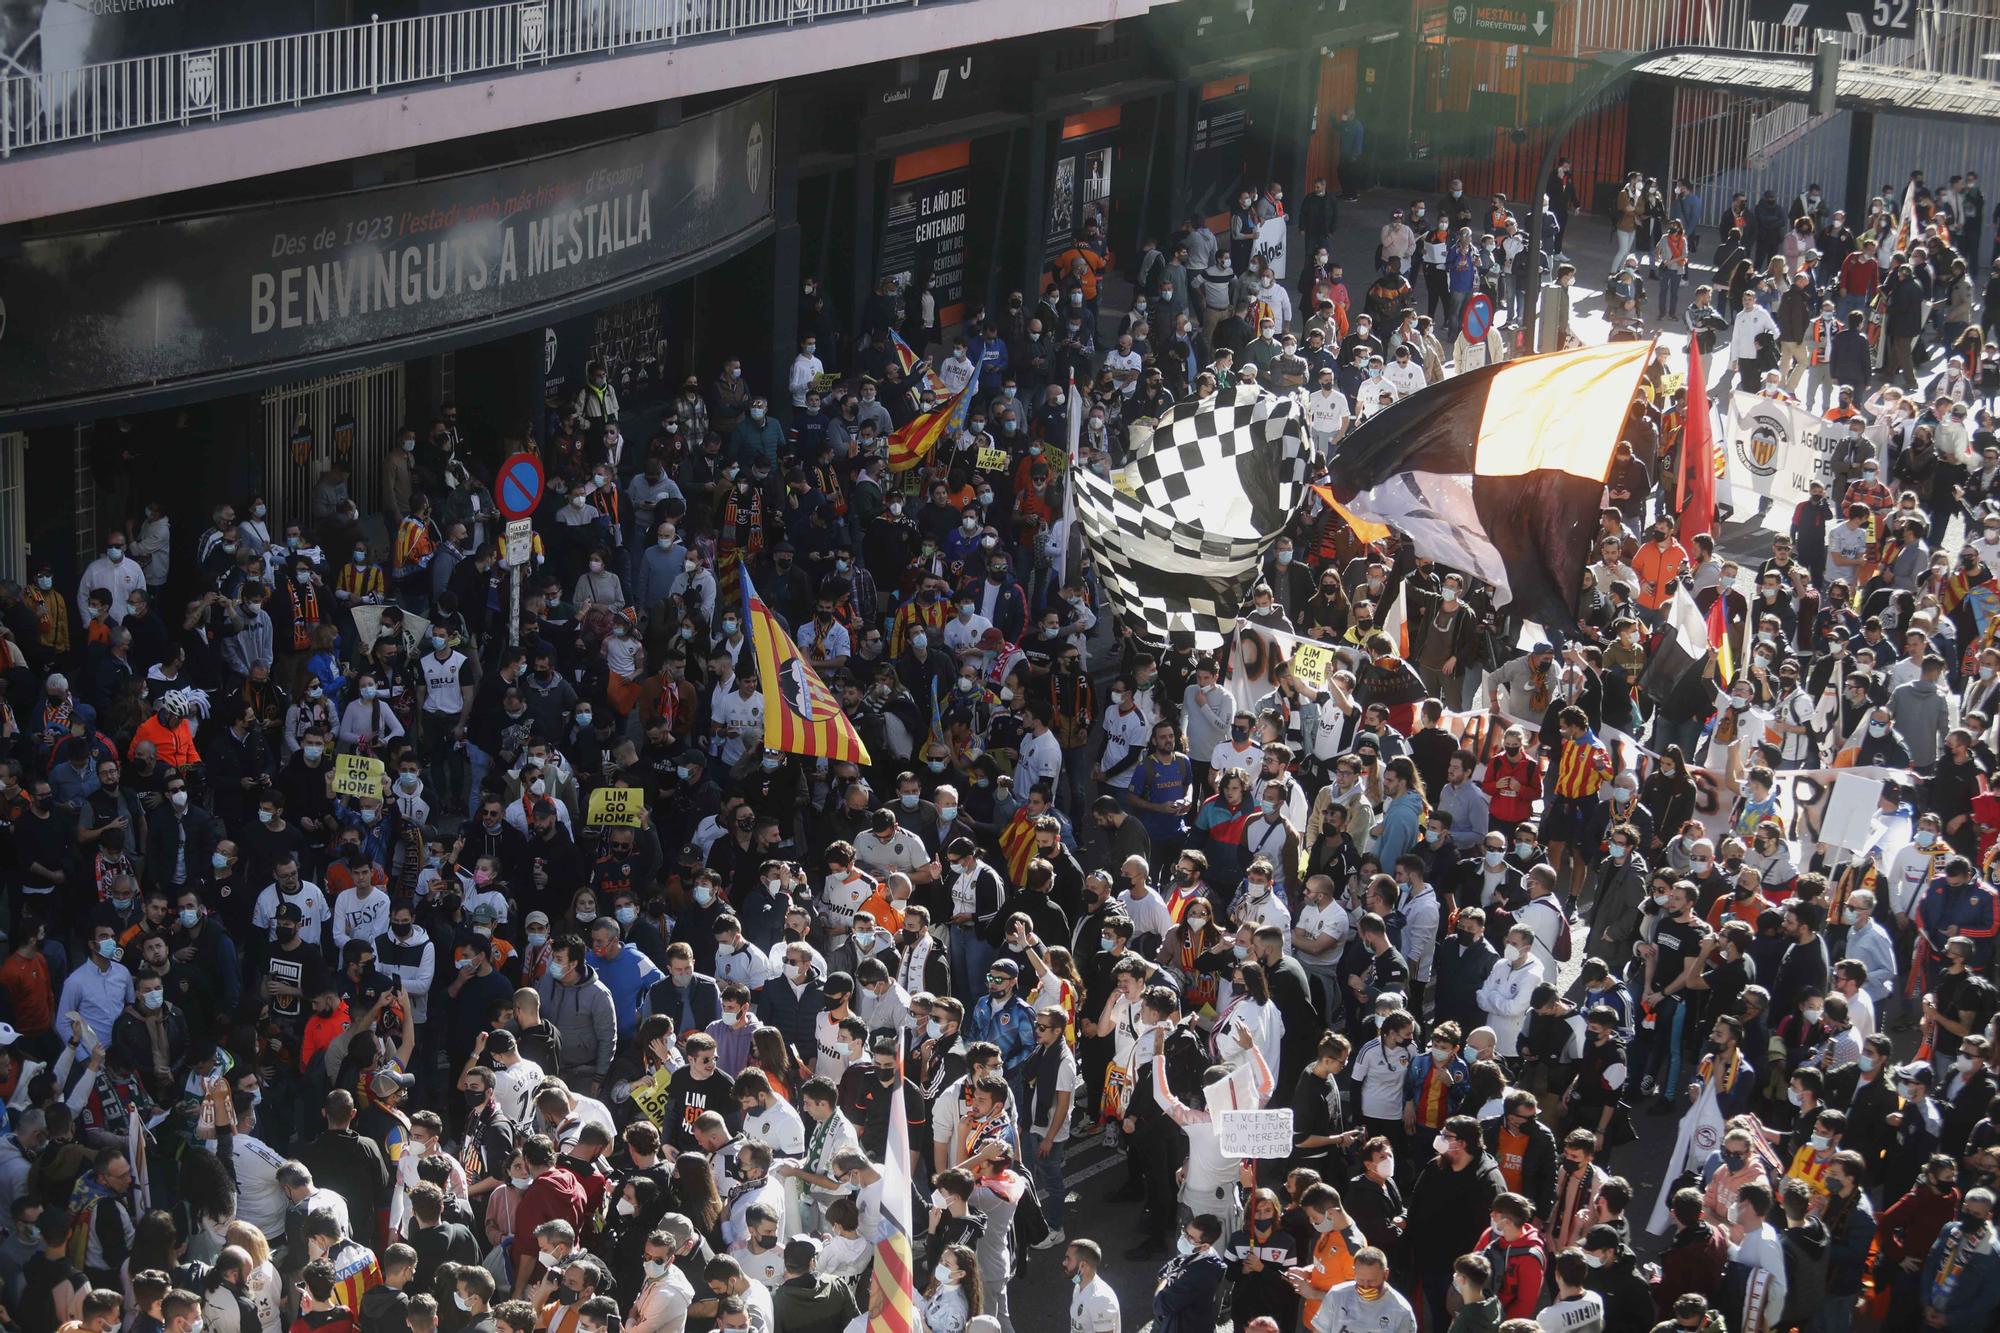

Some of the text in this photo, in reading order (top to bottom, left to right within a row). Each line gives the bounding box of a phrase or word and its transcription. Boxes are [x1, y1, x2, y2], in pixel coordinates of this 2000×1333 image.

[1477, 8, 1527, 23] MESTALLA
[1872, 0, 1908, 28] 52
[1476, 20, 1527, 32] FOREVERTOUR
[960, 57, 972, 80] J
[921, 188, 966, 217] EL AÑO DEL
[915, 213, 966, 244] CENTENARIO
[271, 233, 306, 258] Des
[312, 227, 336, 250] de
[343, 216, 393, 246] 1923
[251, 189, 652, 335] BENVINGUTS A MESTALLA
[934, 268, 963, 289] ENTENARY
[1801, 430, 1838, 453] AGRUP
[984, 449, 1001, 458] LIM
[978, 460, 1002, 470] HOME
[1303, 647, 1320, 659] LIM
[1302, 658, 1316, 669] GO
[1295, 666, 1321, 681] HOME
[1106, 730, 1126, 746] bwin
[348, 757, 370, 771] LIM
[349, 769, 367, 781] GO
[338, 779, 376, 795] HOME
[604, 791, 628, 802] LIM
[606, 802, 626, 813] GO
[593, 813, 634, 823] HOME
[825, 901, 855, 917] bwin
[273, 963, 298, 978] PUMA
[816, 1039, 841, 1060] bwin
[656, 1093, 668, 1105] G
[684, 1091, 707, 1109] LIM
[639, 1093, 664, 1129] HOM
[1223, 1113, 1234, 1122] EL
[1241, 1112, 1259, 1123] VCF
[1255, 1120, 1291, 1131] FUTURO
[1225, 1130, 1292, 1143] YO MEREZCO
[1224, 1145, 1248, 1155] VIVIR
[1251, 1145, 1267, 1155] ESE
[1505, 1153, 1522, 1163] TER
[336, 1254, 372, 1281] VALEN
